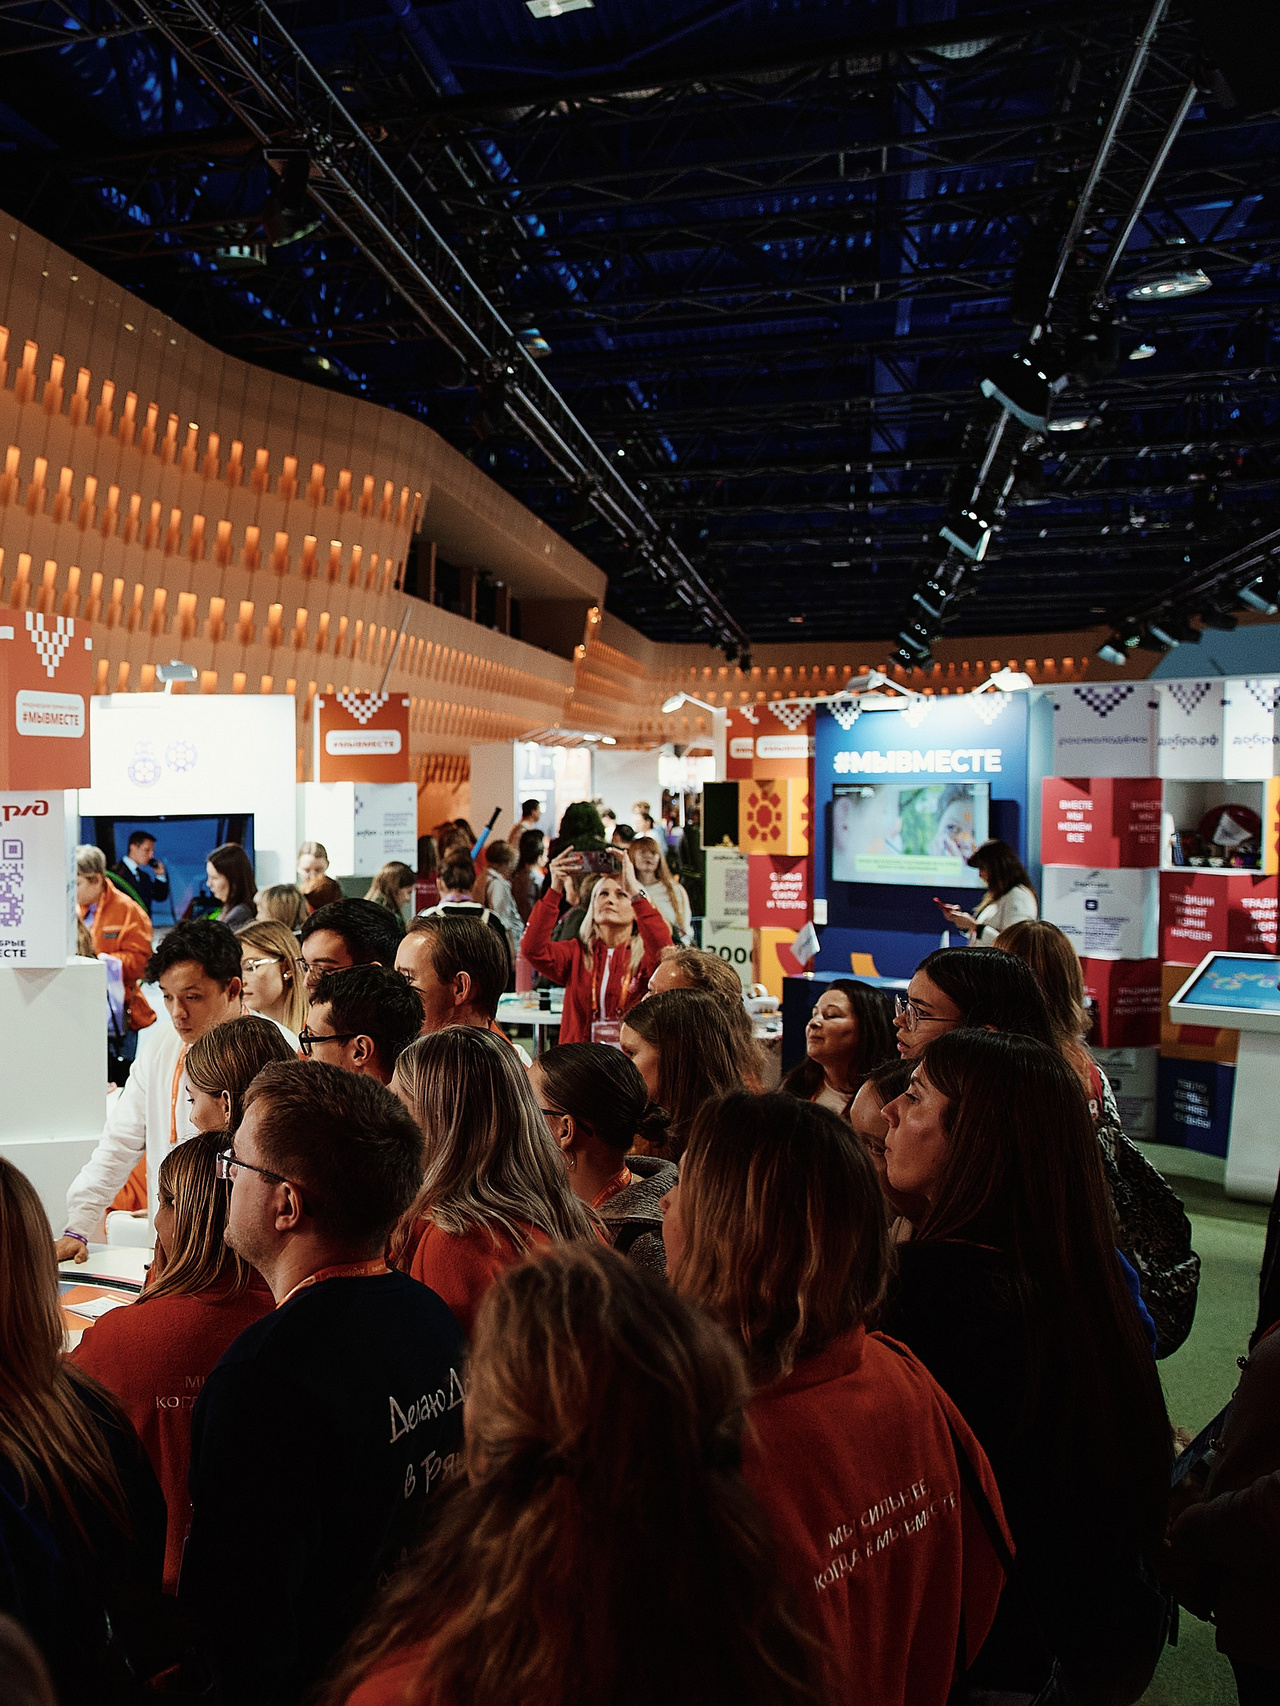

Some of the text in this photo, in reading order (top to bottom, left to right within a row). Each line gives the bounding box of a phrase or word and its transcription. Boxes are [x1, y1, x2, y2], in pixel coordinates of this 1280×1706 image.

[22, 711, 79, 726] #МЫВМЕСТЕ
[833, 748, 1002, 774] #МЫВМЕСТЕ
[1058, 800, 1094, 810] ВМЕСТЕ
[770, 881, 803, 891] ДАРИТ
[776, 900, 807, 910] ТЕПЛО
[828, 1519, 856, 1549] МЫ
[813, 1549, 863, 1593] КОГДА
